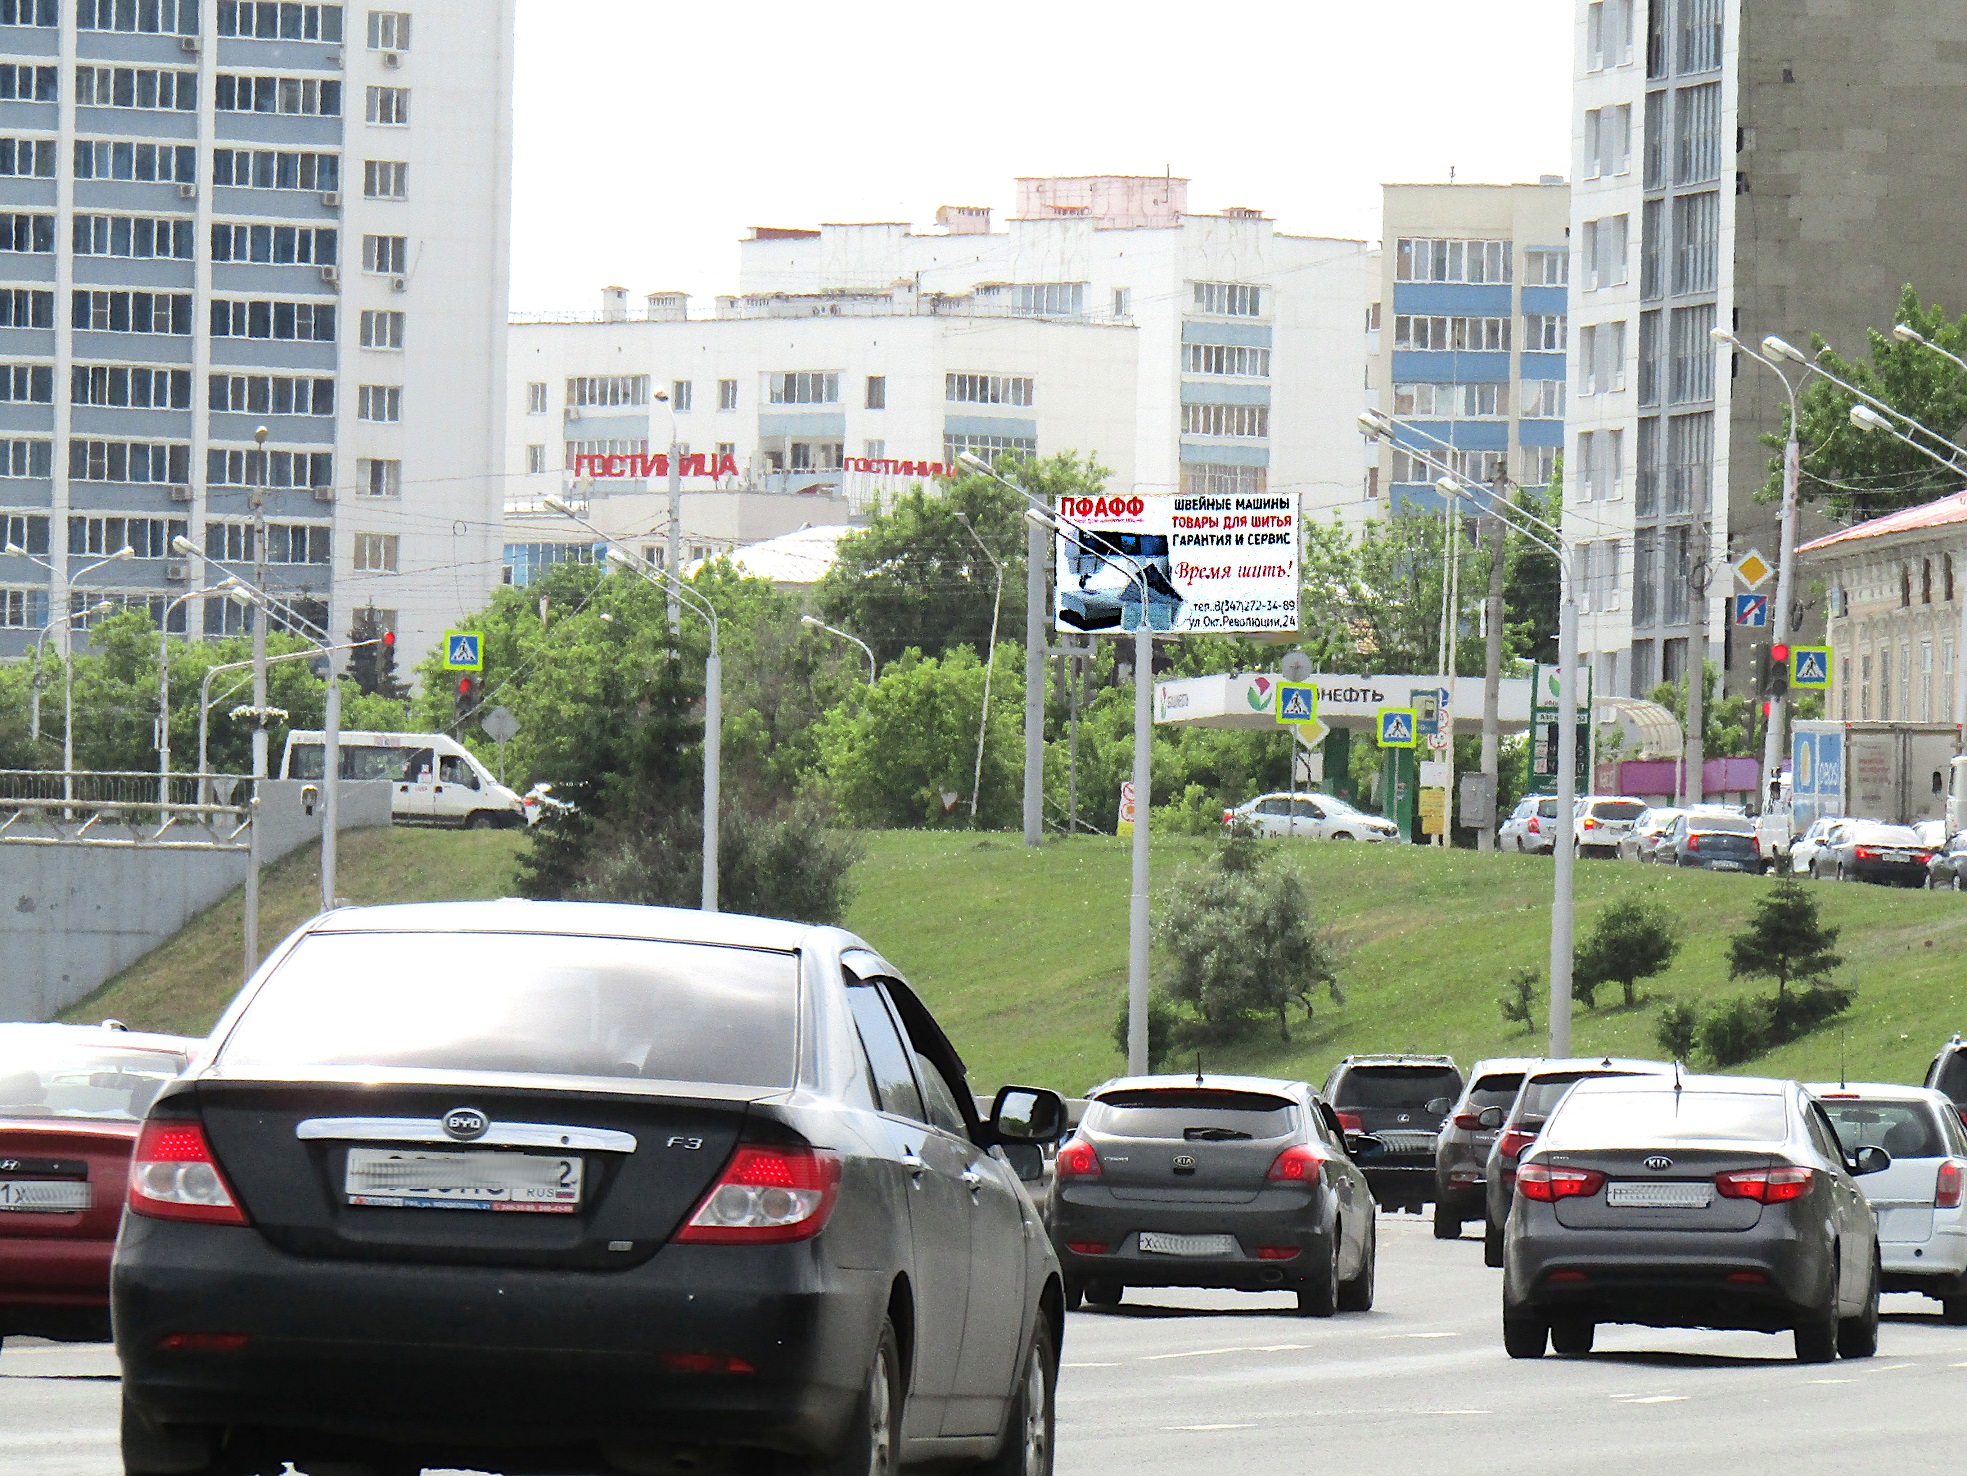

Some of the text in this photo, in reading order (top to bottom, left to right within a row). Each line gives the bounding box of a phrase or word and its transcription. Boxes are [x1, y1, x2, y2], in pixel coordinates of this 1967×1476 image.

[844, 457, 958, 477] ГОСТИНИЦ
[1061, 496, 1144, 517] ПФАФФ
[1174, 496, 1290, 511] ШВЕЙНЫЕ МАШИНЫ
[1172, 514, 1292, 530] ТОВАРЫ ДЛЯ ШИТЬЯ
[1172, 532, 1291, 547] ГАРАНТИЯ И СЕРВИС
[1174, 560, 1293, 586] Время шить!
[1316, 687, 1385, 703] НЕФТЬ
[449, 1117, 481, 1129] BYD
[666, 1136, 703, 1150] F3
[1648, 1159, 1669, 1169] KIA
